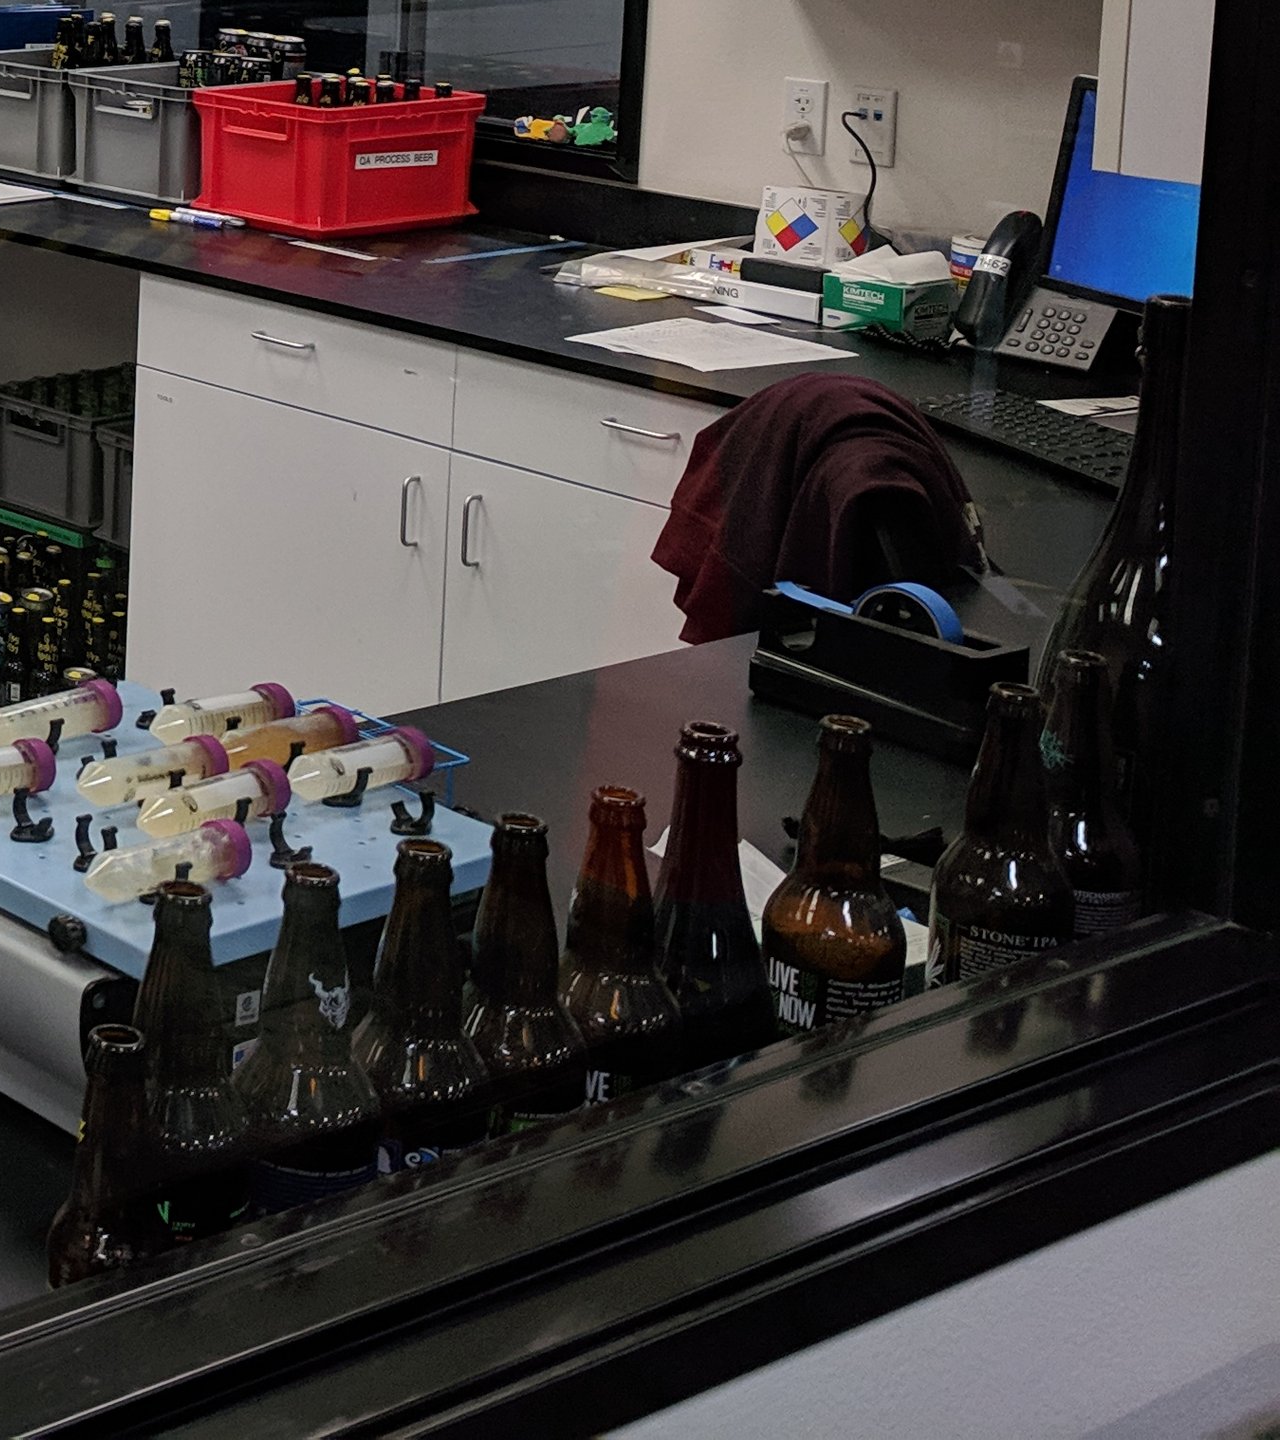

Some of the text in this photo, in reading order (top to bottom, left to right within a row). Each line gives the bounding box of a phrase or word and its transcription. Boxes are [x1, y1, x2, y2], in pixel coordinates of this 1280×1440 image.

[359, 152, 434, 165] QA PROCESS BEER
[843, 285, 885, 301] KIMTECH
[1033, 935, 1059, 948] IPA
[769, 956, 800, 997] LIVE
[779, 991, 817, 1030] NOW
